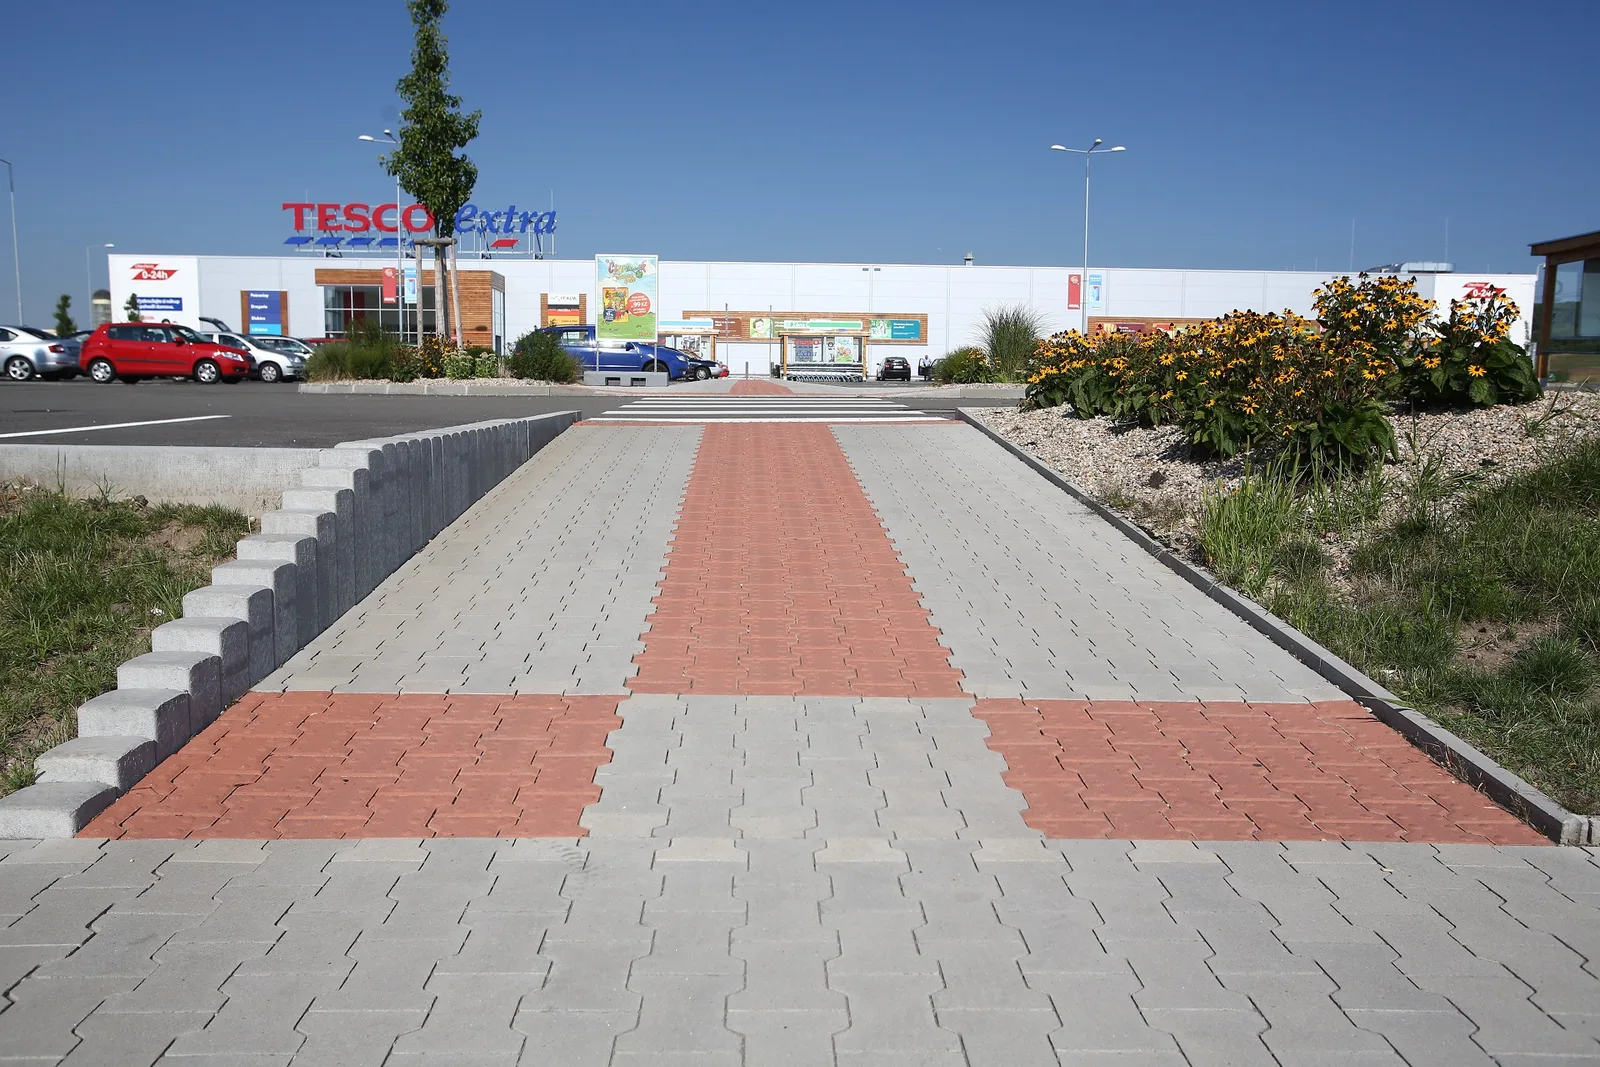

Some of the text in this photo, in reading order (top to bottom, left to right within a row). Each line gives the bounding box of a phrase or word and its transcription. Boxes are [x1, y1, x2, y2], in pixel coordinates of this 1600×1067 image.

[282, 203, 557, 234] TESCO extra
[141, 270, 169, 279] 0-24h
[1472, 288, 1498, 297] 0-24
